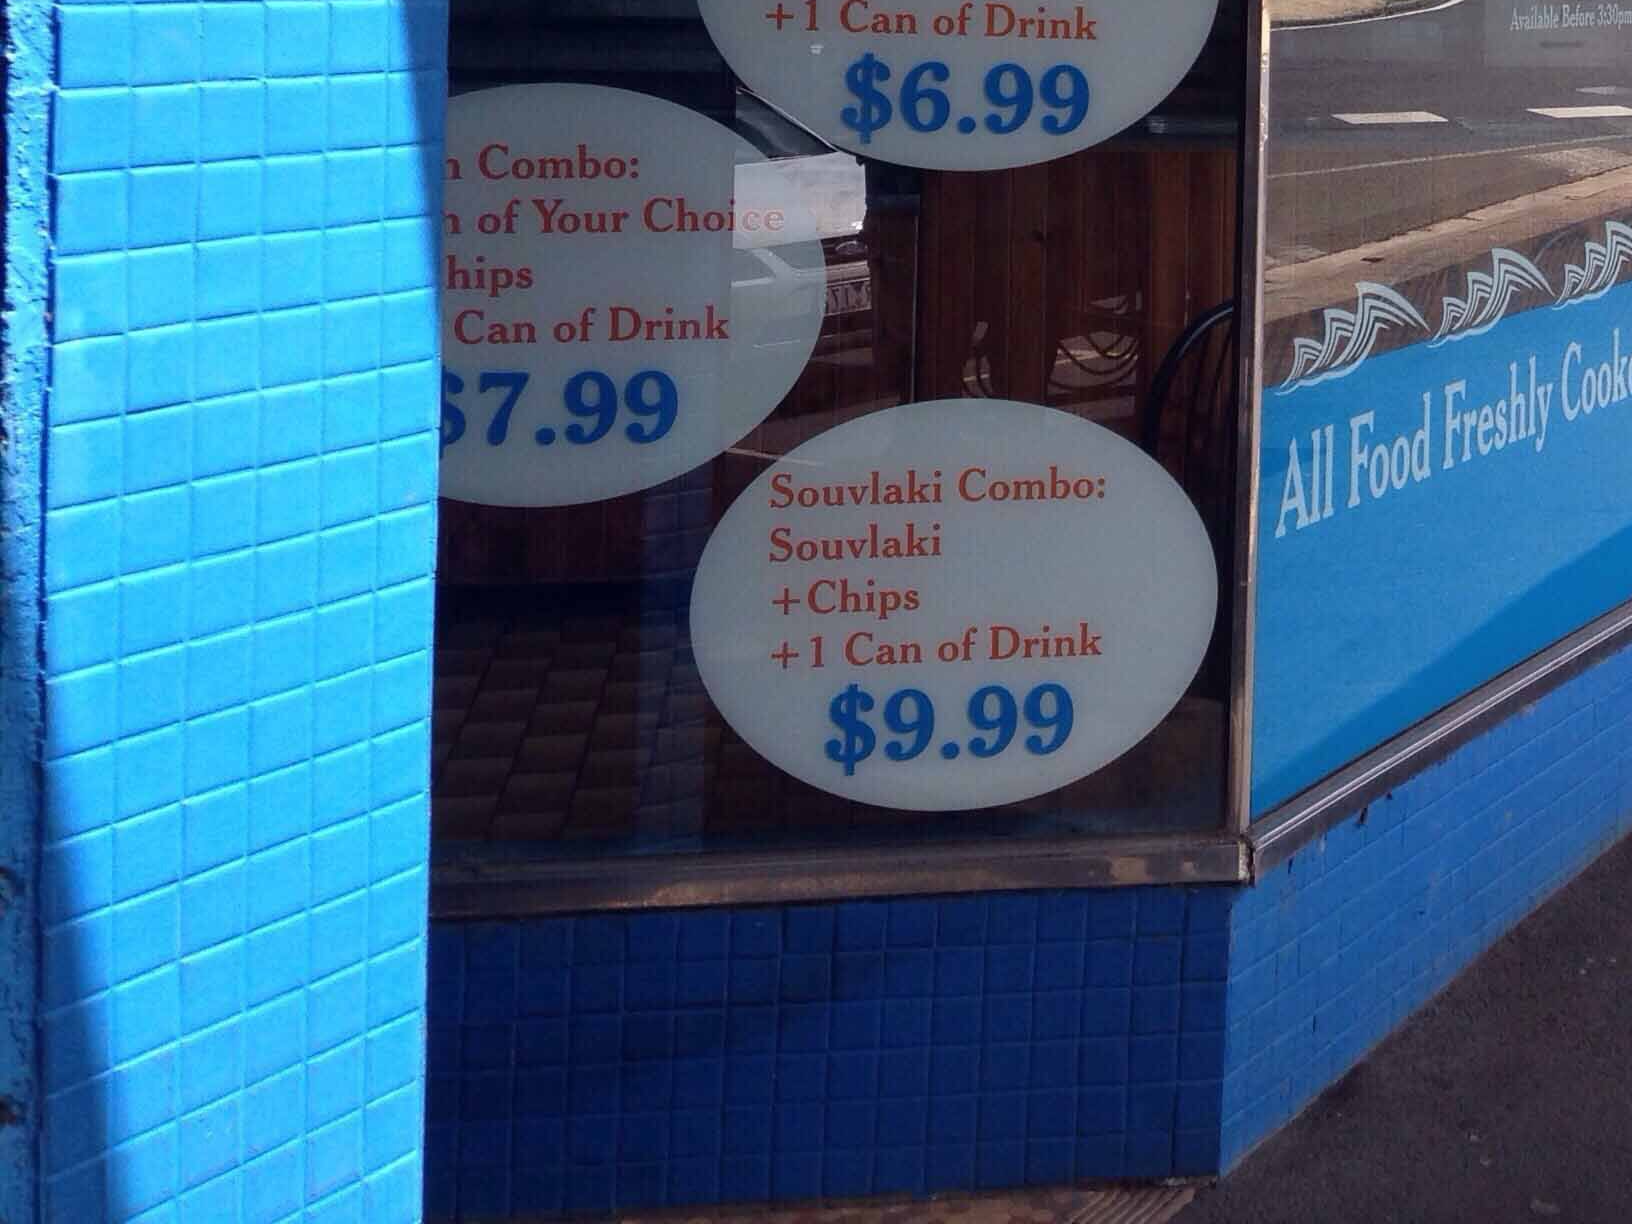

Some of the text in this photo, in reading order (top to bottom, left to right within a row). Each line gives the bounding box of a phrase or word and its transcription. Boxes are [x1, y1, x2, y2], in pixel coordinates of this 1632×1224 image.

[932, 2, 972, 37] of
[984, 3, 1098, 41] Drink
[1510, 3, 1632, 31] Available Before 3:30pm
[840, 52, 1091, 145] $6.99
[478, 143, 640, 181] Combo:
[477, 198, 520, 234] of
[530, 199, 629, 234] Your
[643, 197, 786, 233] Choice
[446, 254, 534, 297] hips
[453, 305, 730, 345] Can of Drink
[1274, 424, 1335, 539] All
[1347, 392, 1432, 509] Food
[1442, 352, 1554, 470] Freshly
[769, 466, 1106, 509] Souvlaki Combo:
[769, 523, 942, 563] Souvlaki
[844, 631, 922, 667] Can
[937, 627, 980, 664] of
[988, 622, 1103, 662] Drink
[824, 682, 1075, 777] $9.99
